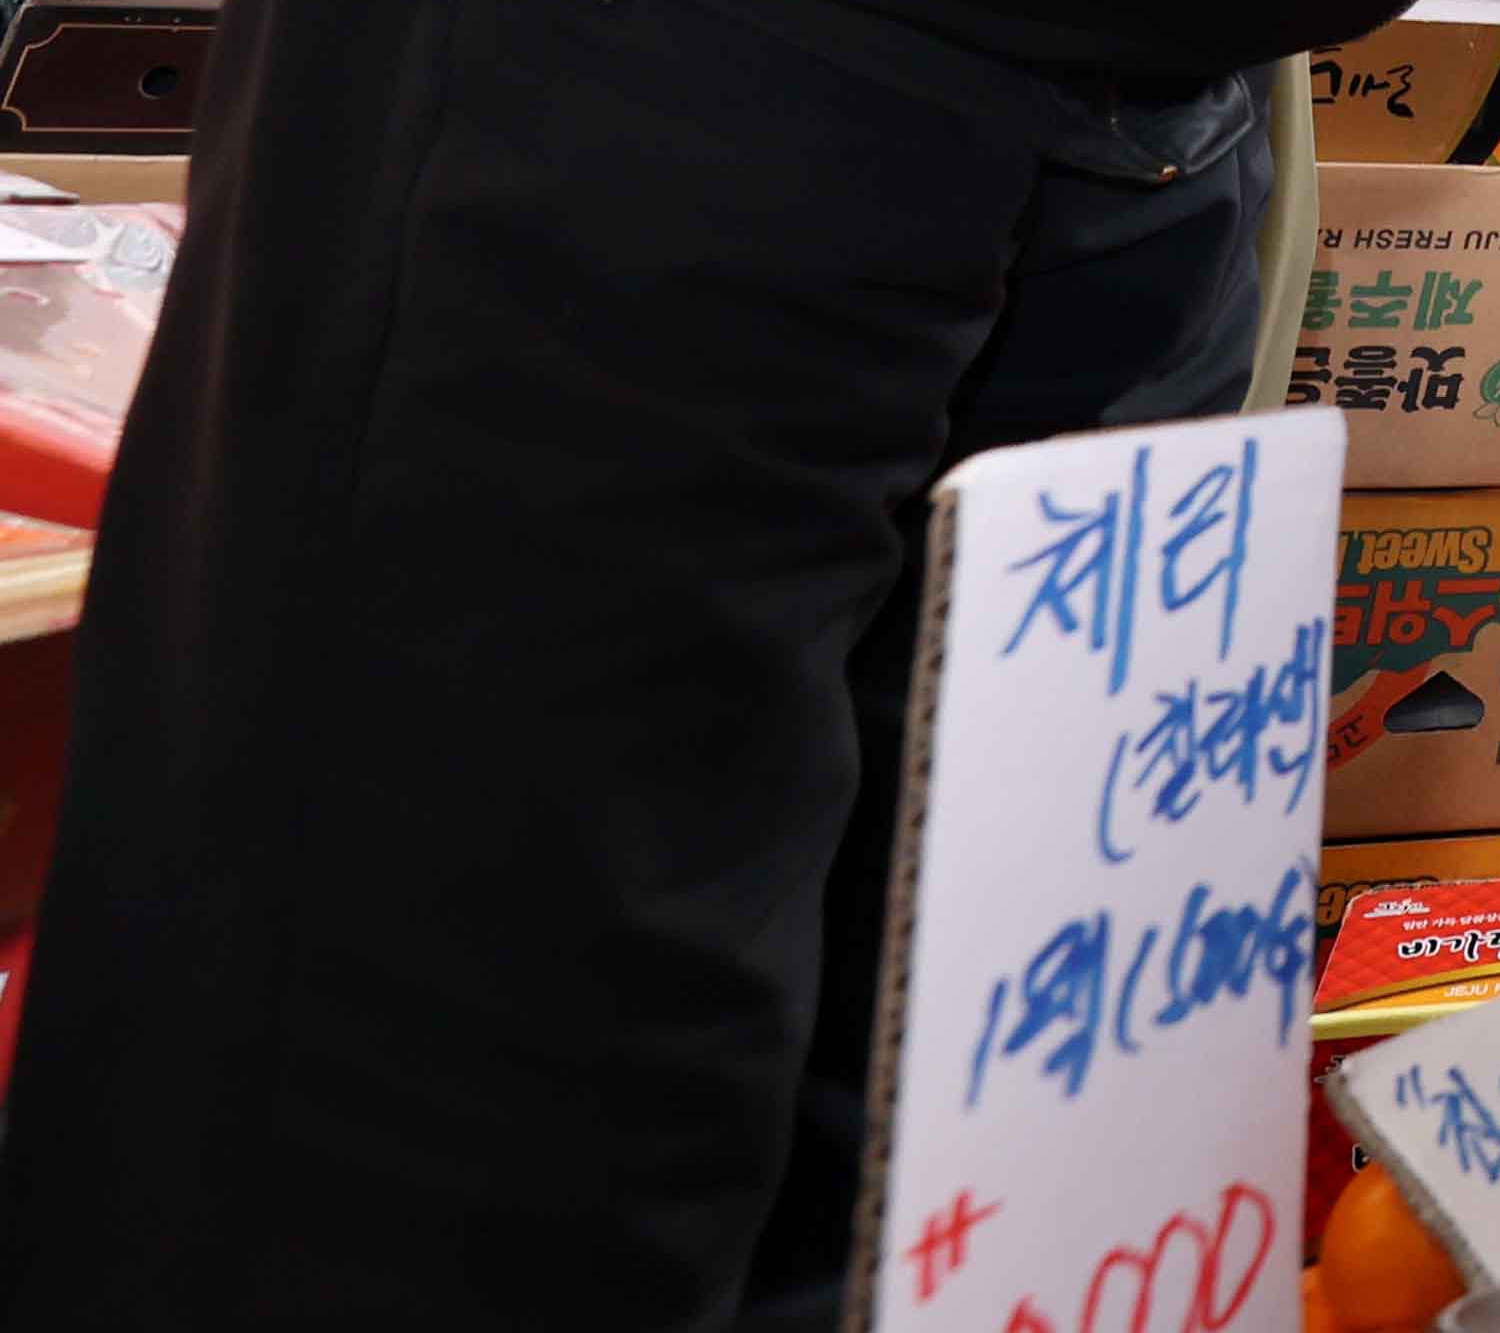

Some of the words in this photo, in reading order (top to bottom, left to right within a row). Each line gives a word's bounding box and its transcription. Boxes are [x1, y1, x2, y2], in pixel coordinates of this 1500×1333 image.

[1354, 226, 1453, 251] FRESH
[1356, 526, 1491, 574] Sweet
[1444, 984, 1490, 998] JEJU
